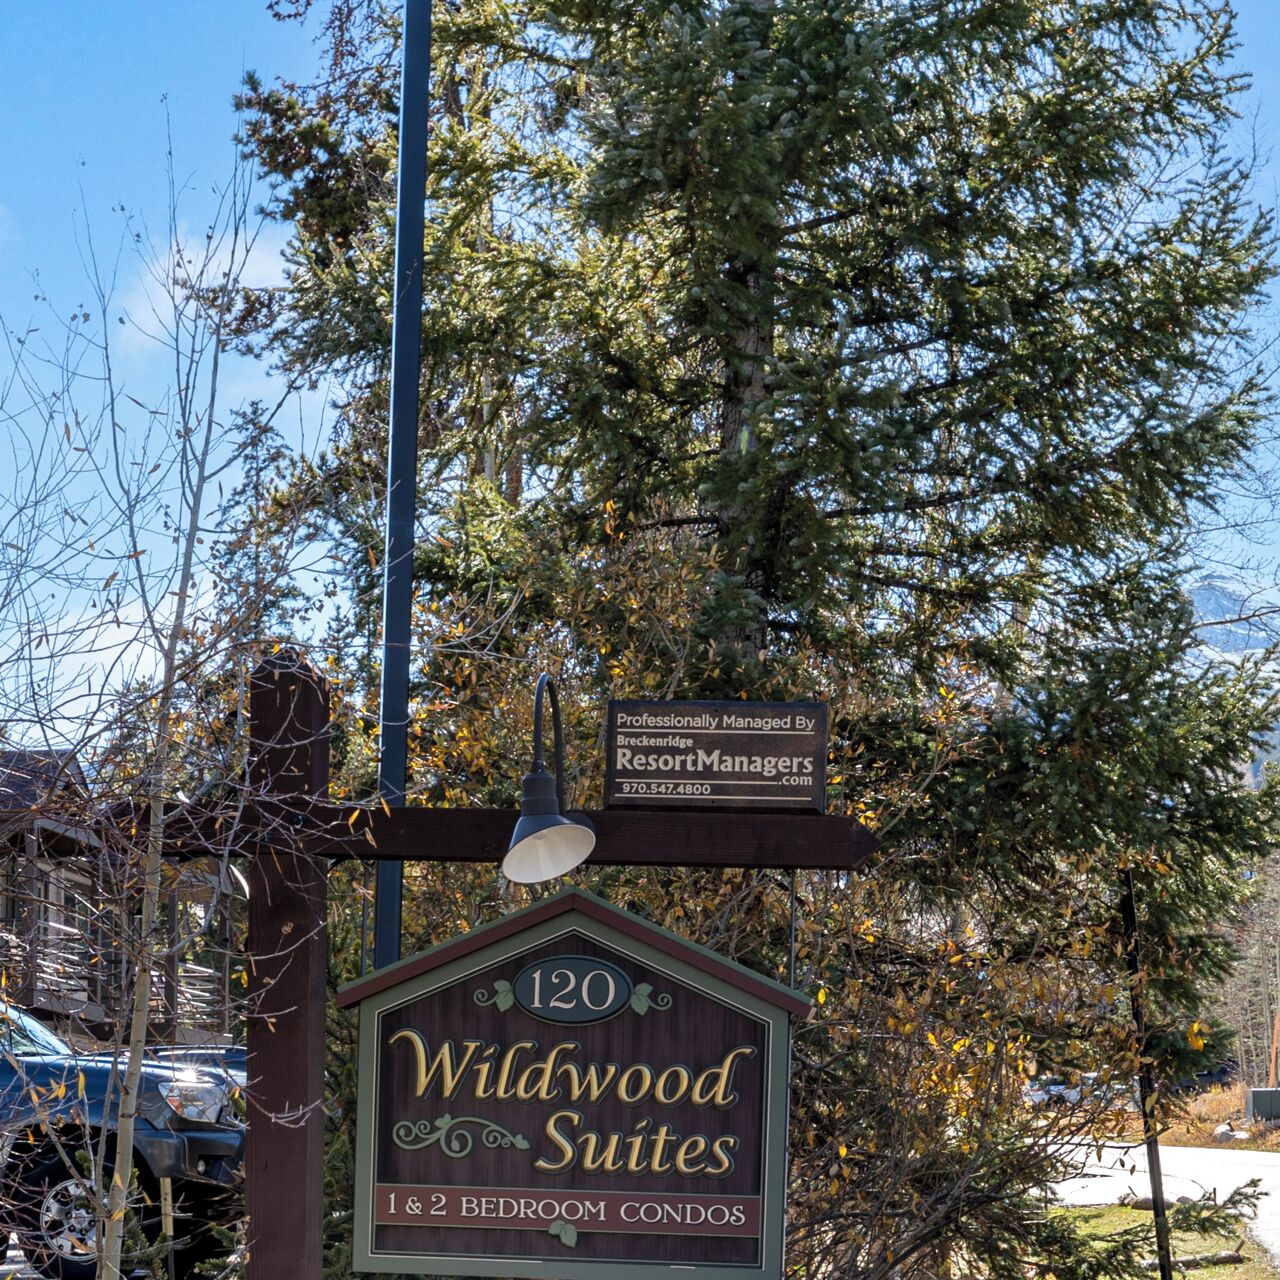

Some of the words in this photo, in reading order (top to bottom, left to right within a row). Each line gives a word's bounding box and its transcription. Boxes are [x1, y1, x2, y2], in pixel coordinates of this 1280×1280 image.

[617, 713, 719, 730] Professionally
[723, 714, 791, 731] Managed
[796, 715, 815, 731] By
[616, 734, 694, 749] Breckenridge
[616, 748, 814, 777] ResortManagers
[622, 782, 711, 795] 970.547.4800
[778, 775, 813, 786] .com
[529, 968, 616, 1010] 120
[388, 1028, 754, 1106] Wildwood
[534, 1110, 736, 1174] Suites
[387, 1192, 397, 1215] 1
[405, 1196, 423, 1216] &
[430, 1193, 447, 1216] 2
[459, 1197, 607, 1221] BEDROOM
[620, 1201, 746, 1226] CONDOS
